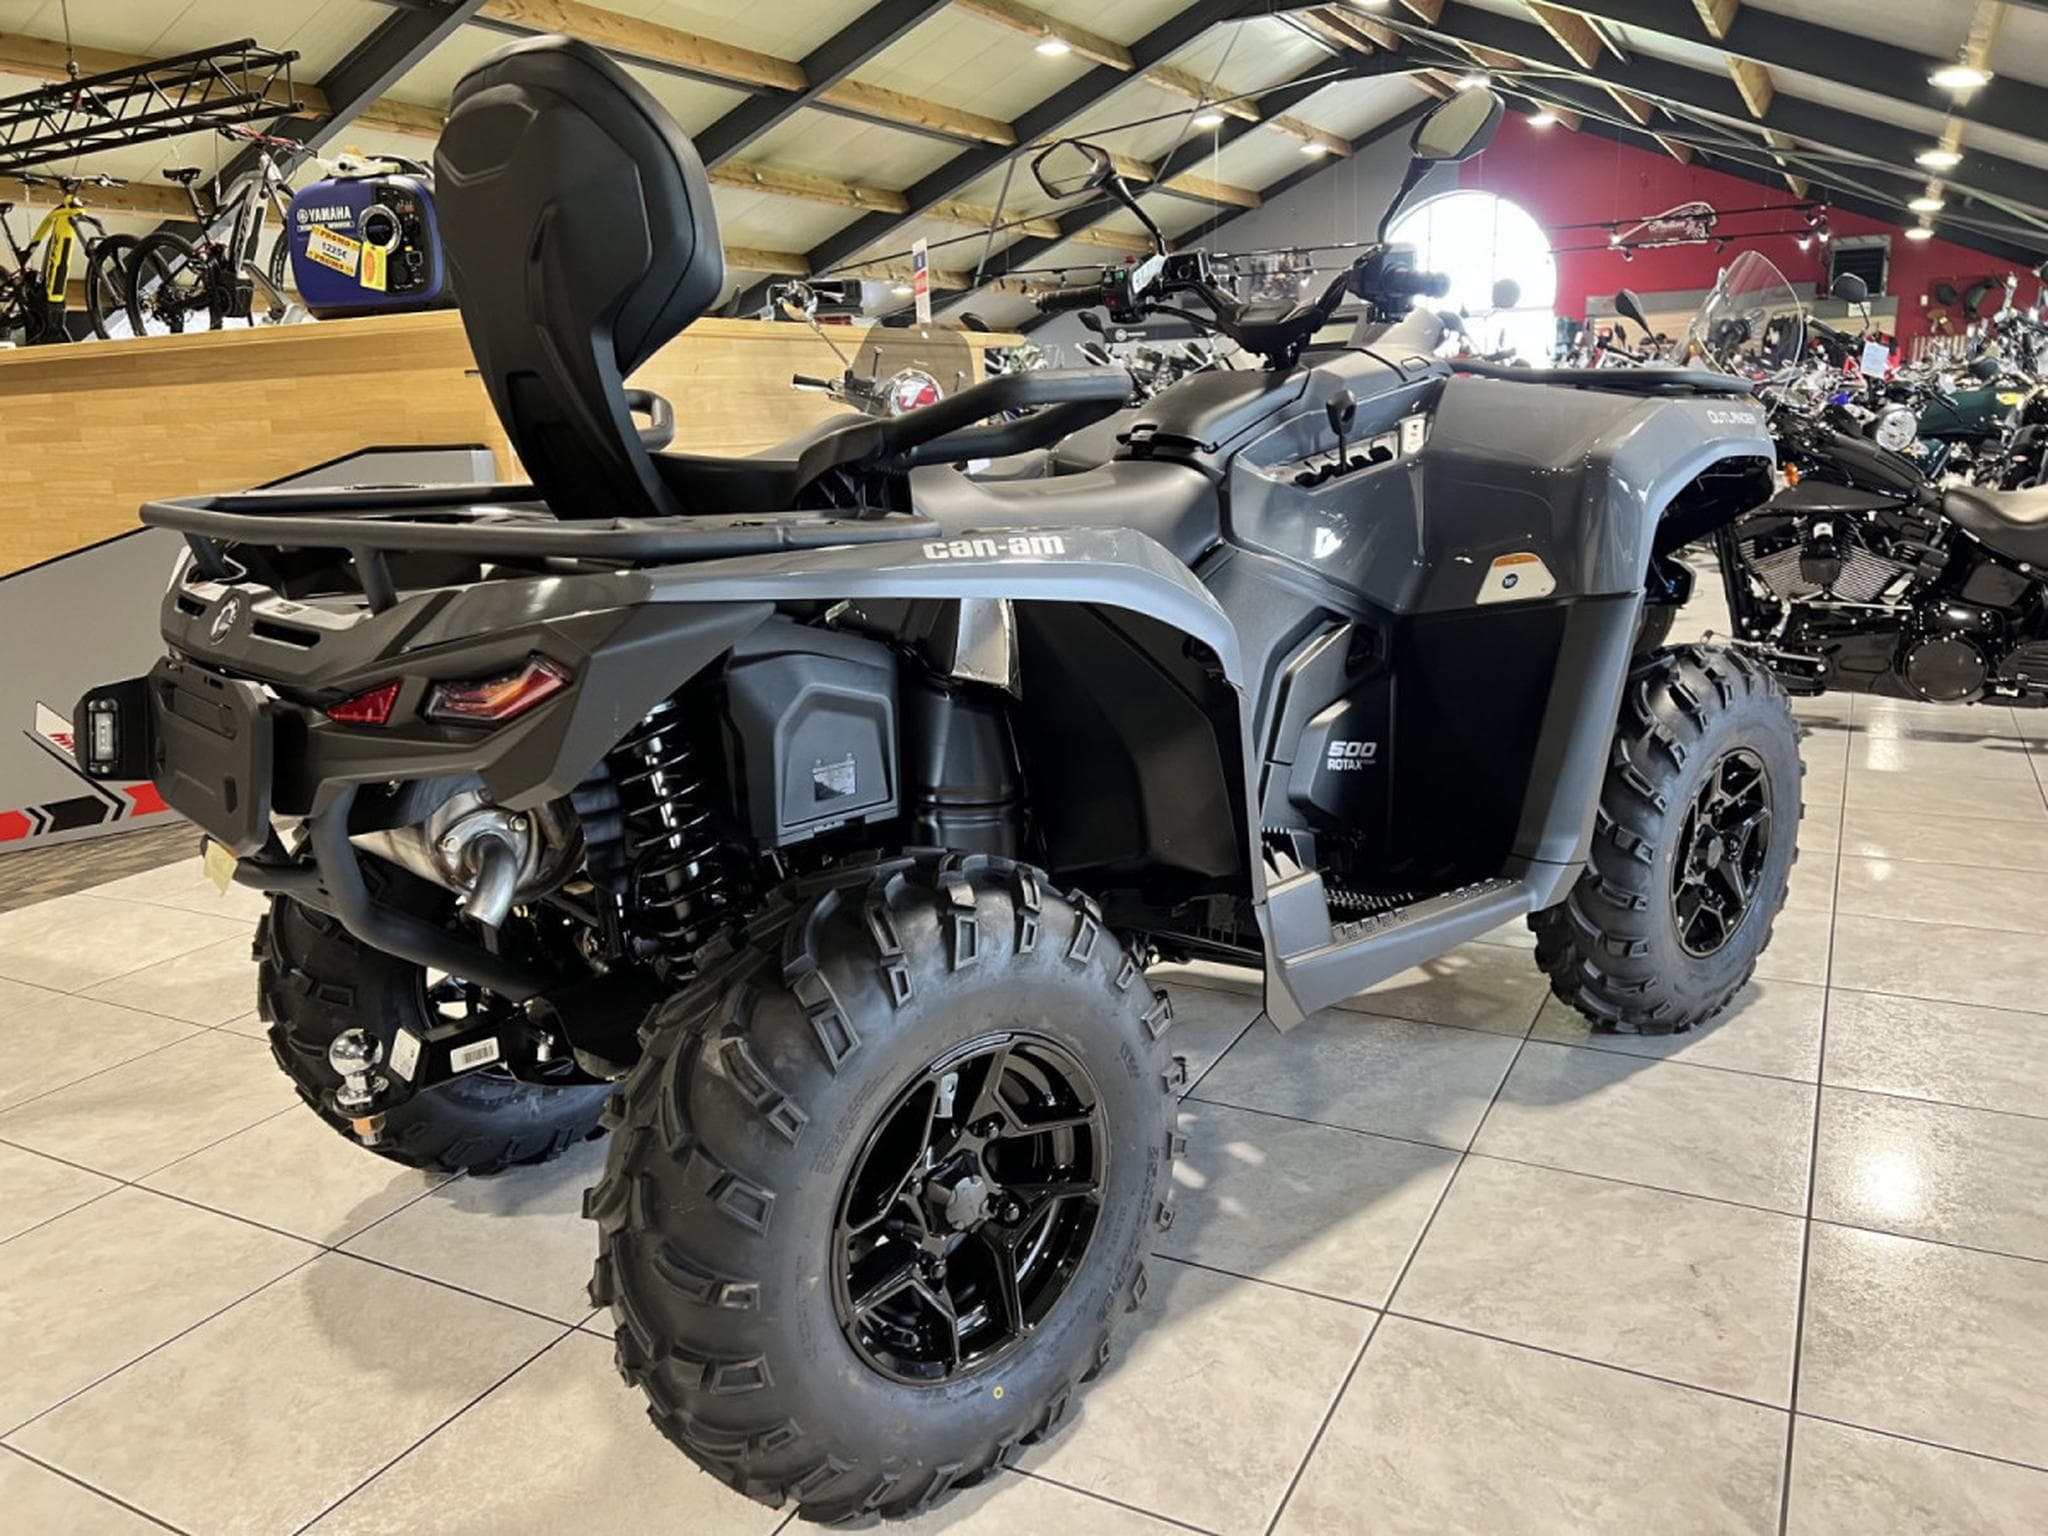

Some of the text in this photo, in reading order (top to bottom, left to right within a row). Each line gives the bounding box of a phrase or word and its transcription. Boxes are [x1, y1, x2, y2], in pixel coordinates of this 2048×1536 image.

[308, 206, 351, 221] YAMAHA
[922, 535, 1066, 560] can-am
[1328, 741, 1377, 757] 500
[1327, 758, 1363, 770] ROTAX
